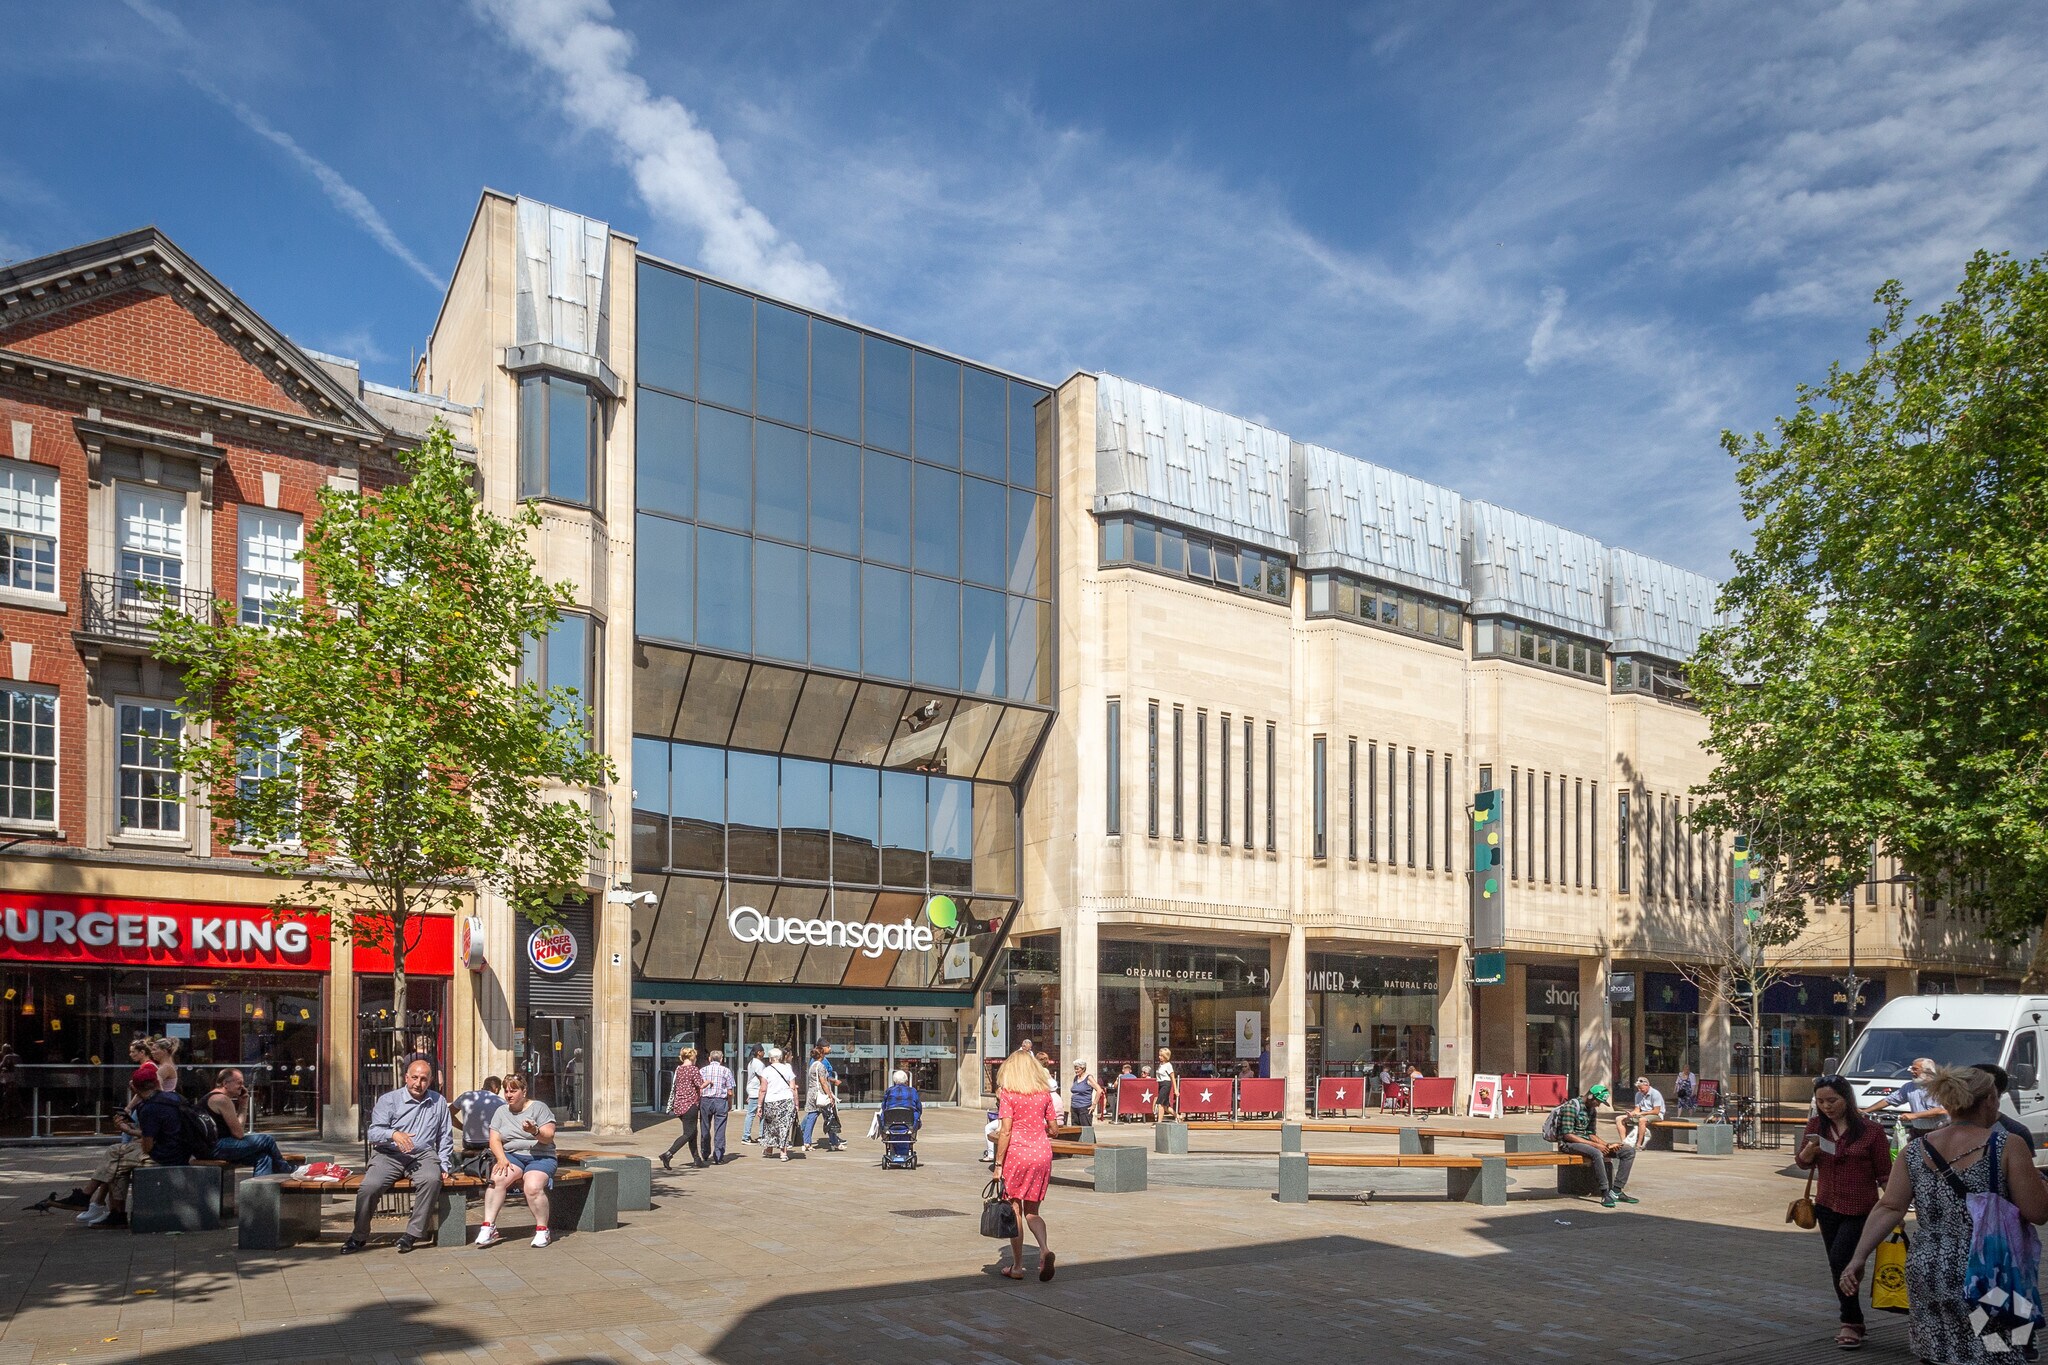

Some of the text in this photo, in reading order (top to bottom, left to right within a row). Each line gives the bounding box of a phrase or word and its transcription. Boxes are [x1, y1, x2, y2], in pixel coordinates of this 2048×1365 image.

[0, 907, 309, 953] URGER KING
[728, 905, 933, 959] Queensgate
[534, 934, 571, 949] BURGER
[535, 942, 572, 961] KING
[1126, 967, 1213, 980] ORGANIC COFFEE
[1305, 970, 1344, 991] MANGER
[1384, 980, 1438, 990] NATURAL FOO
[1545, 984, 1579, 1011] sharp
[1833, 992, 1867, 1006] phaacy
